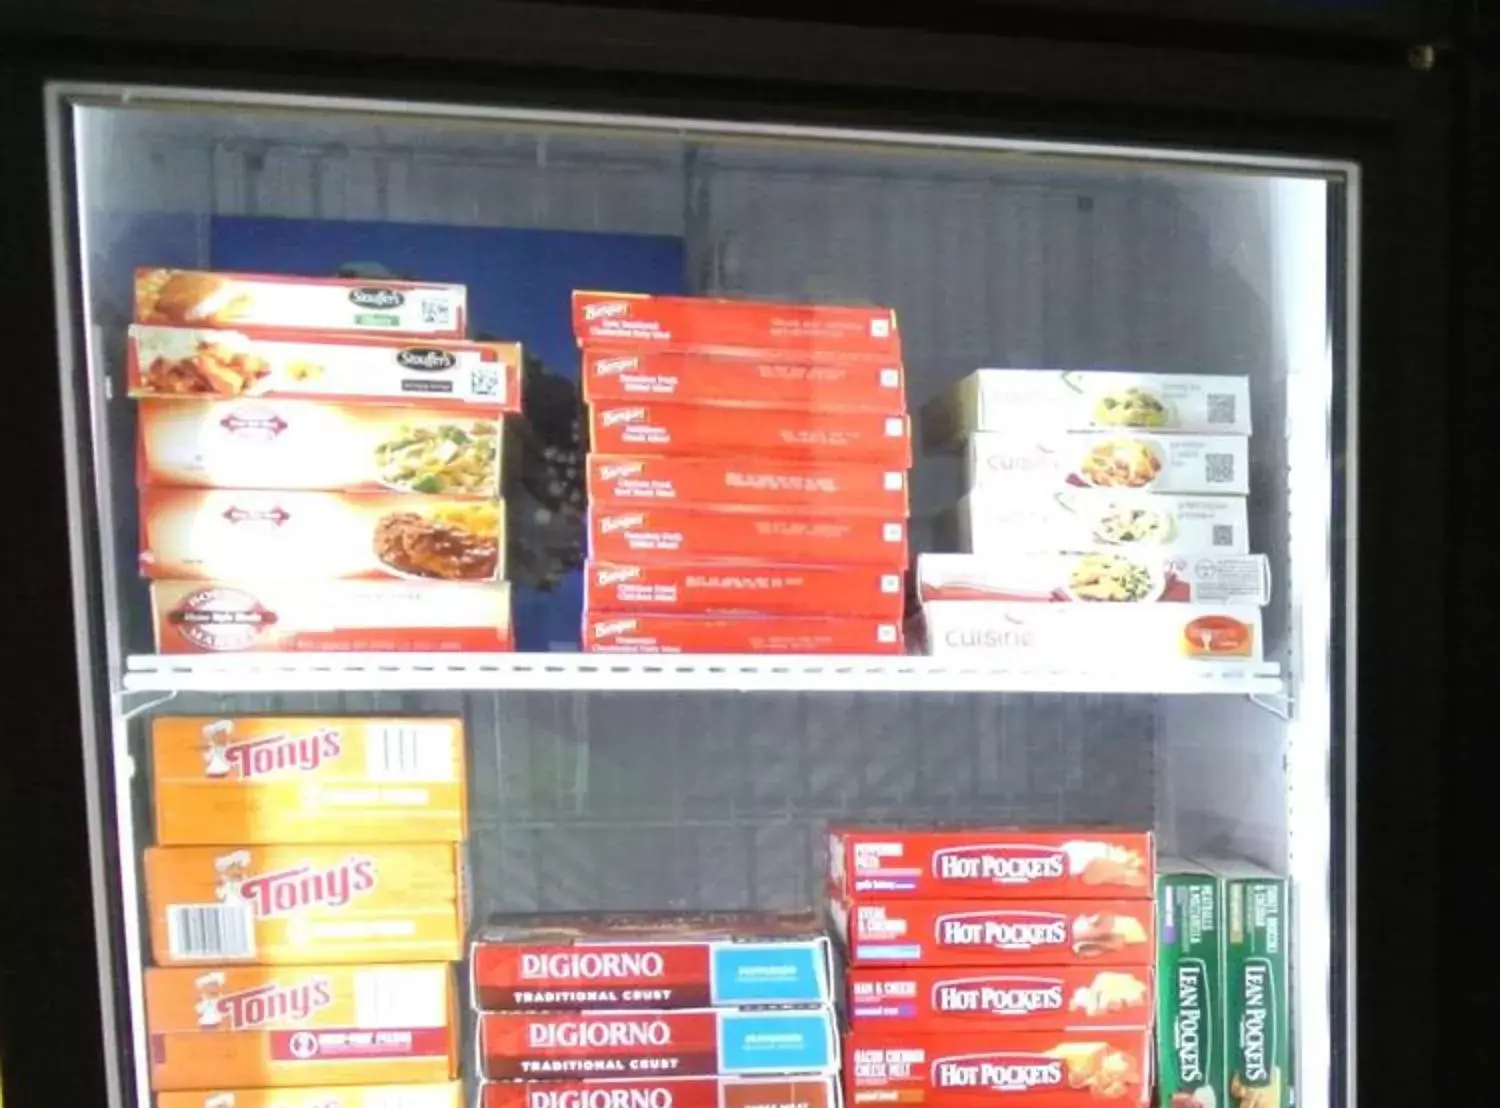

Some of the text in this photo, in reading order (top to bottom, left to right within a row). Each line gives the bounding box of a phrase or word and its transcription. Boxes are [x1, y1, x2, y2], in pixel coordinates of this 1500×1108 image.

[225, 728, 341, 778] Tony's
[941, 854, 1063, 880] HOT POCKETS
[241, 856, 374, 916] Tony's
[944, 920, 1067, 945] HOT POCKETS
[521, 952, 664, 979] DIGIORNO
[513, 989, 672, 1004] TRADITIONAL CRUST
[940, 986, 1063, 1010] HOT POCKETS
[529, 1020, 672, 1047] DIGIORNO
[1179, 966, 1202, 1082] LEAN POCKETS
[1244, 965, 1267, 1082] LEAN POCKETS
[521, 1057, 679, 1073] TRADITIONAL CRUST
[940, 1062, 1062, 1087] HOT POCKETS
